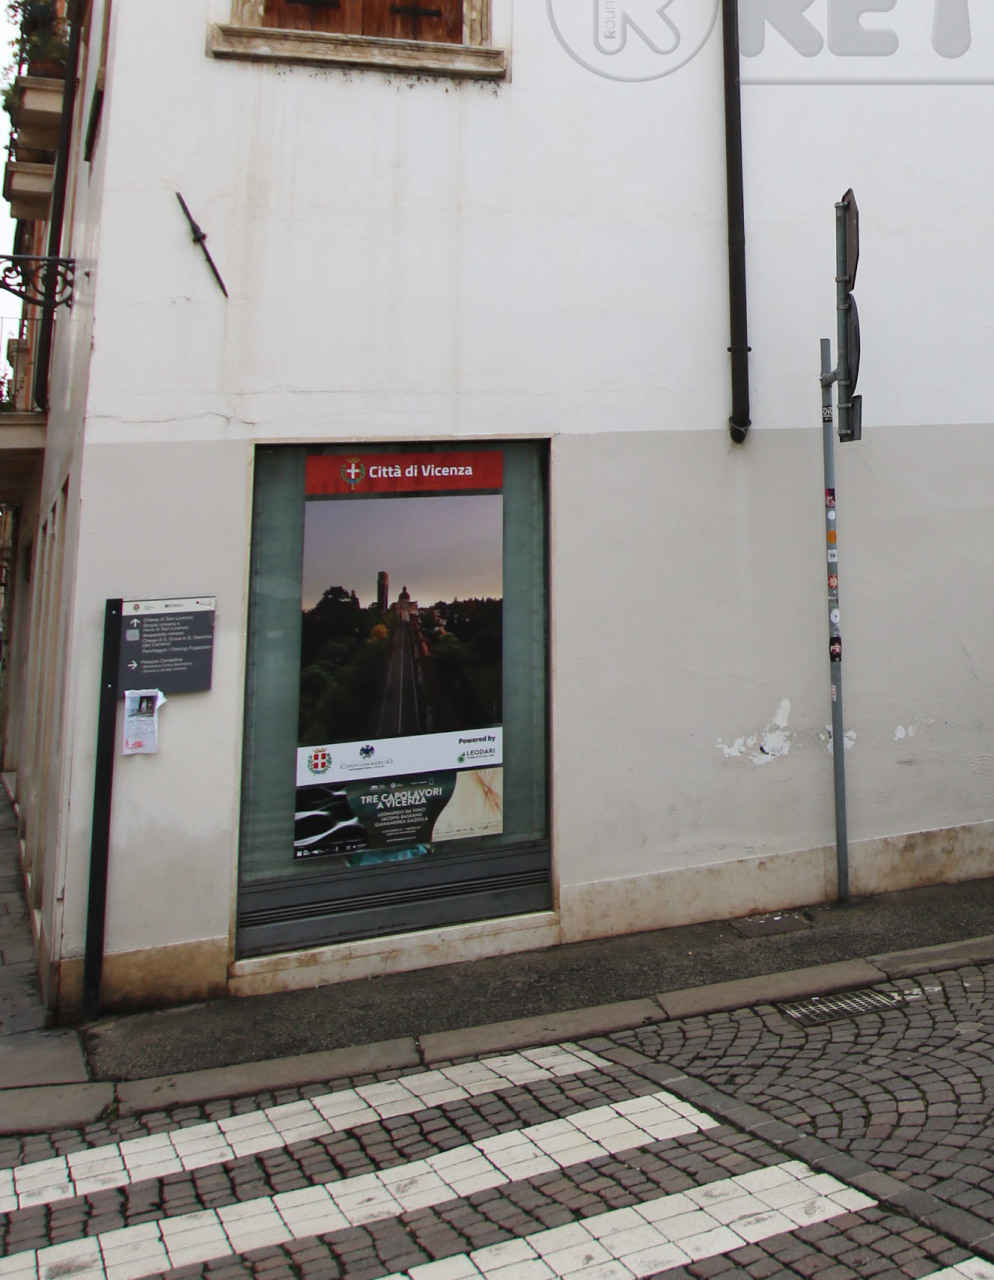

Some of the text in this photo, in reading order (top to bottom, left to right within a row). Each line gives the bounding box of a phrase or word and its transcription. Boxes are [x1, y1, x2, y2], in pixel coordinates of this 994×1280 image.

[369, 464, 473, 478] Città di Vicenza
[458, 735, 496, 745] Powered by
[466, 748, 496, 756] LEODARI
[360, 787, 442, 805] TRE CAPOLAVORI
[376, 796, 427, 809] A VICENZA
